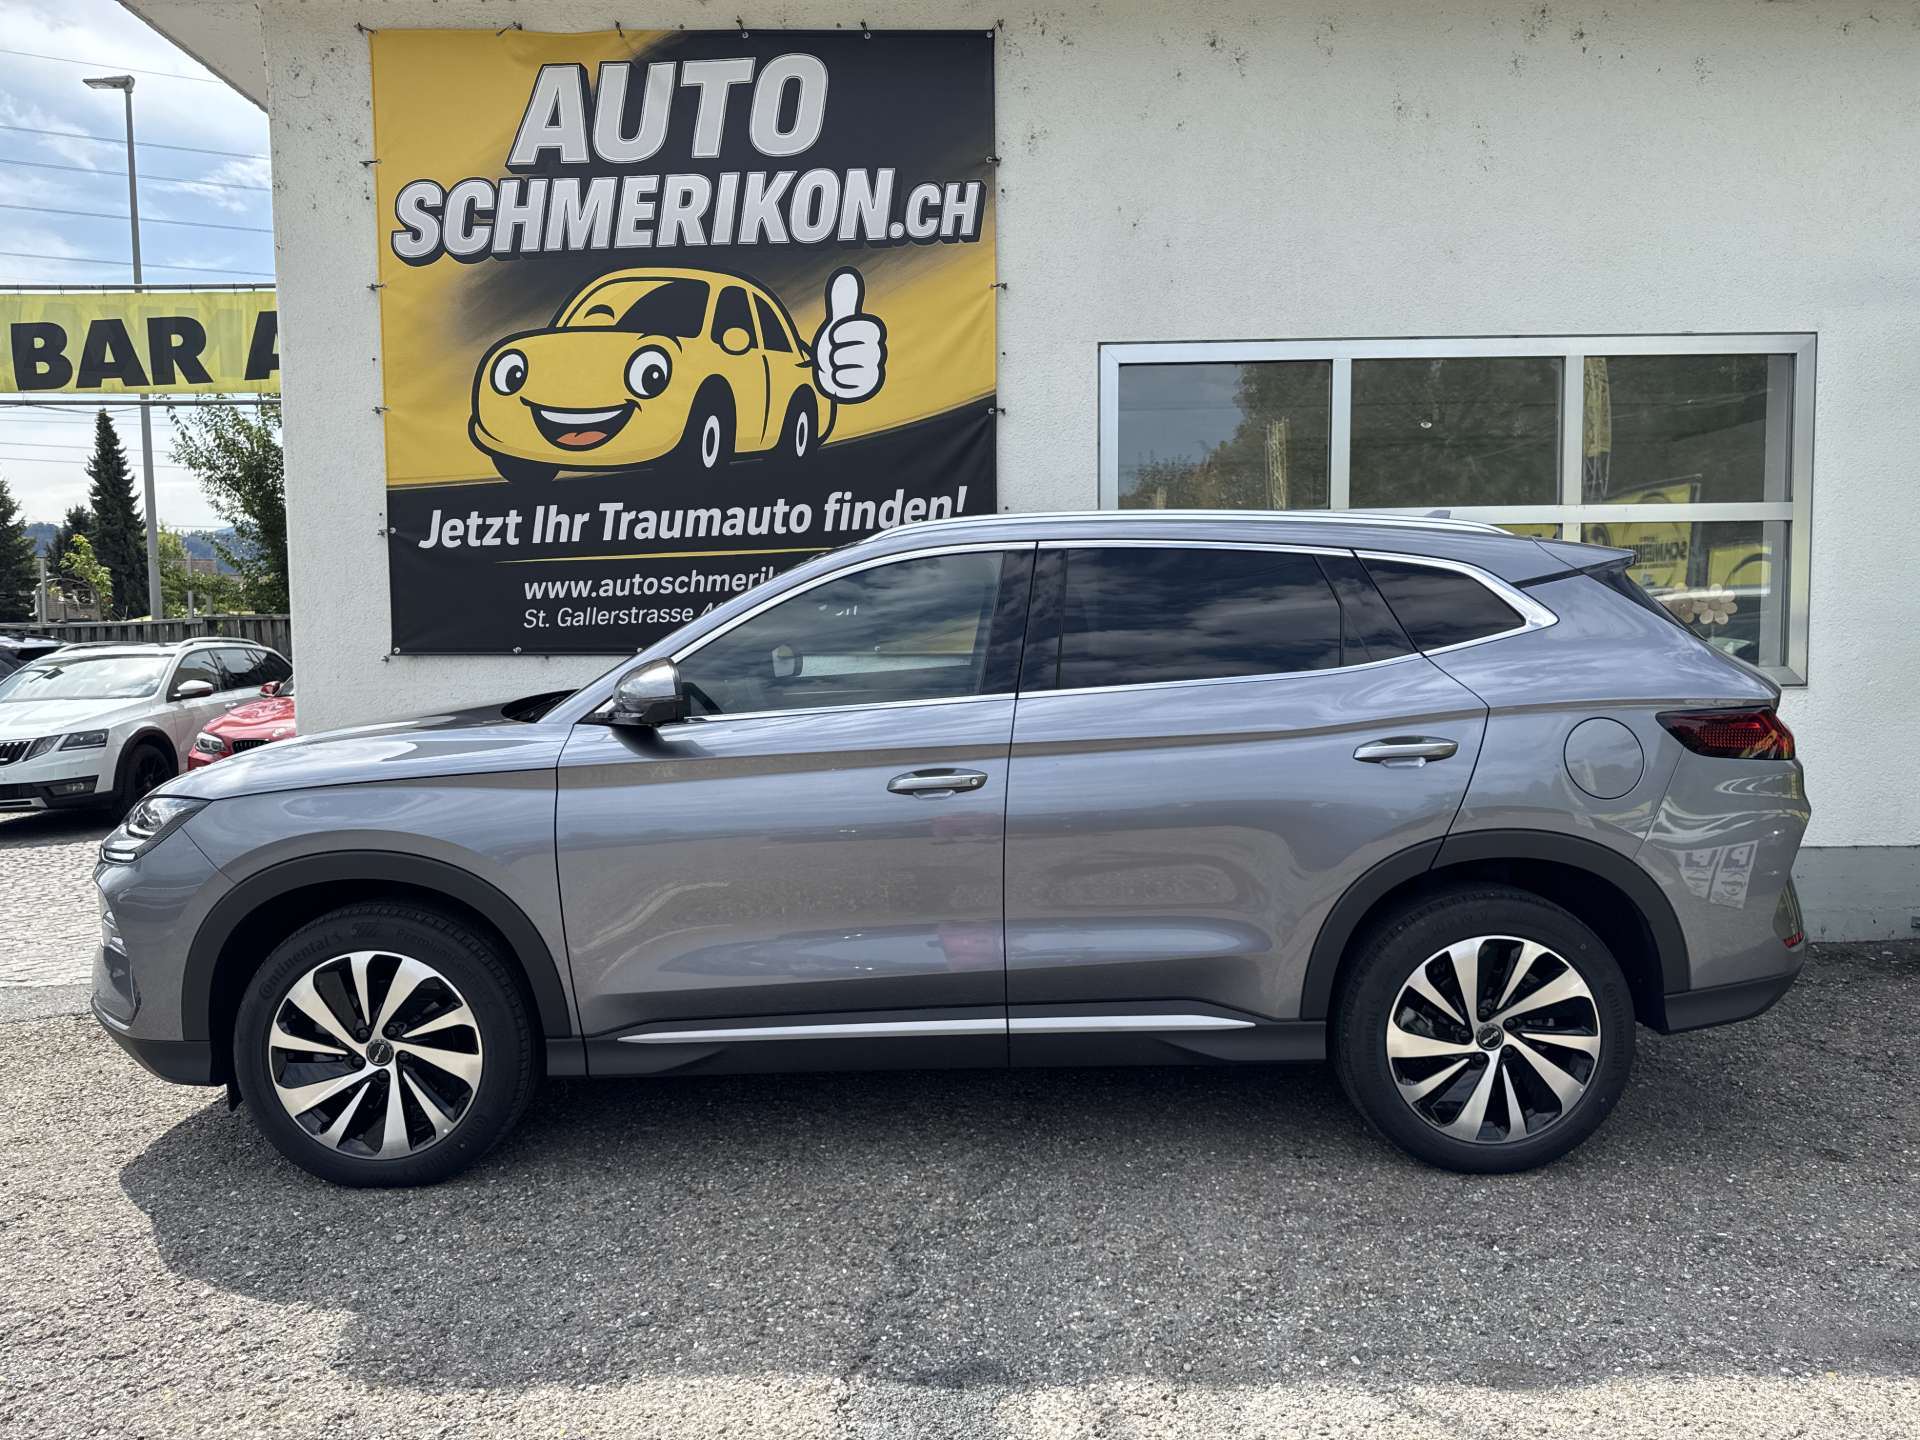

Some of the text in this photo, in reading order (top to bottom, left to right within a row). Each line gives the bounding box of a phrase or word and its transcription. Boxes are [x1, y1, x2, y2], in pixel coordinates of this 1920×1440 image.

[506, 52, 830, 167] AUTO
[391, 166, 984, 260] SCHMERIKON.CH
[10, 315, 215, 392] BAR
[418, 485, 969, 550] Jetzt Ihr Traumauto finden!
[523, 565, 782, 601] www.autoschmeri
[523, 608, 550, 630] St.
[557, 604, 694, 628] Gallerstrasse
